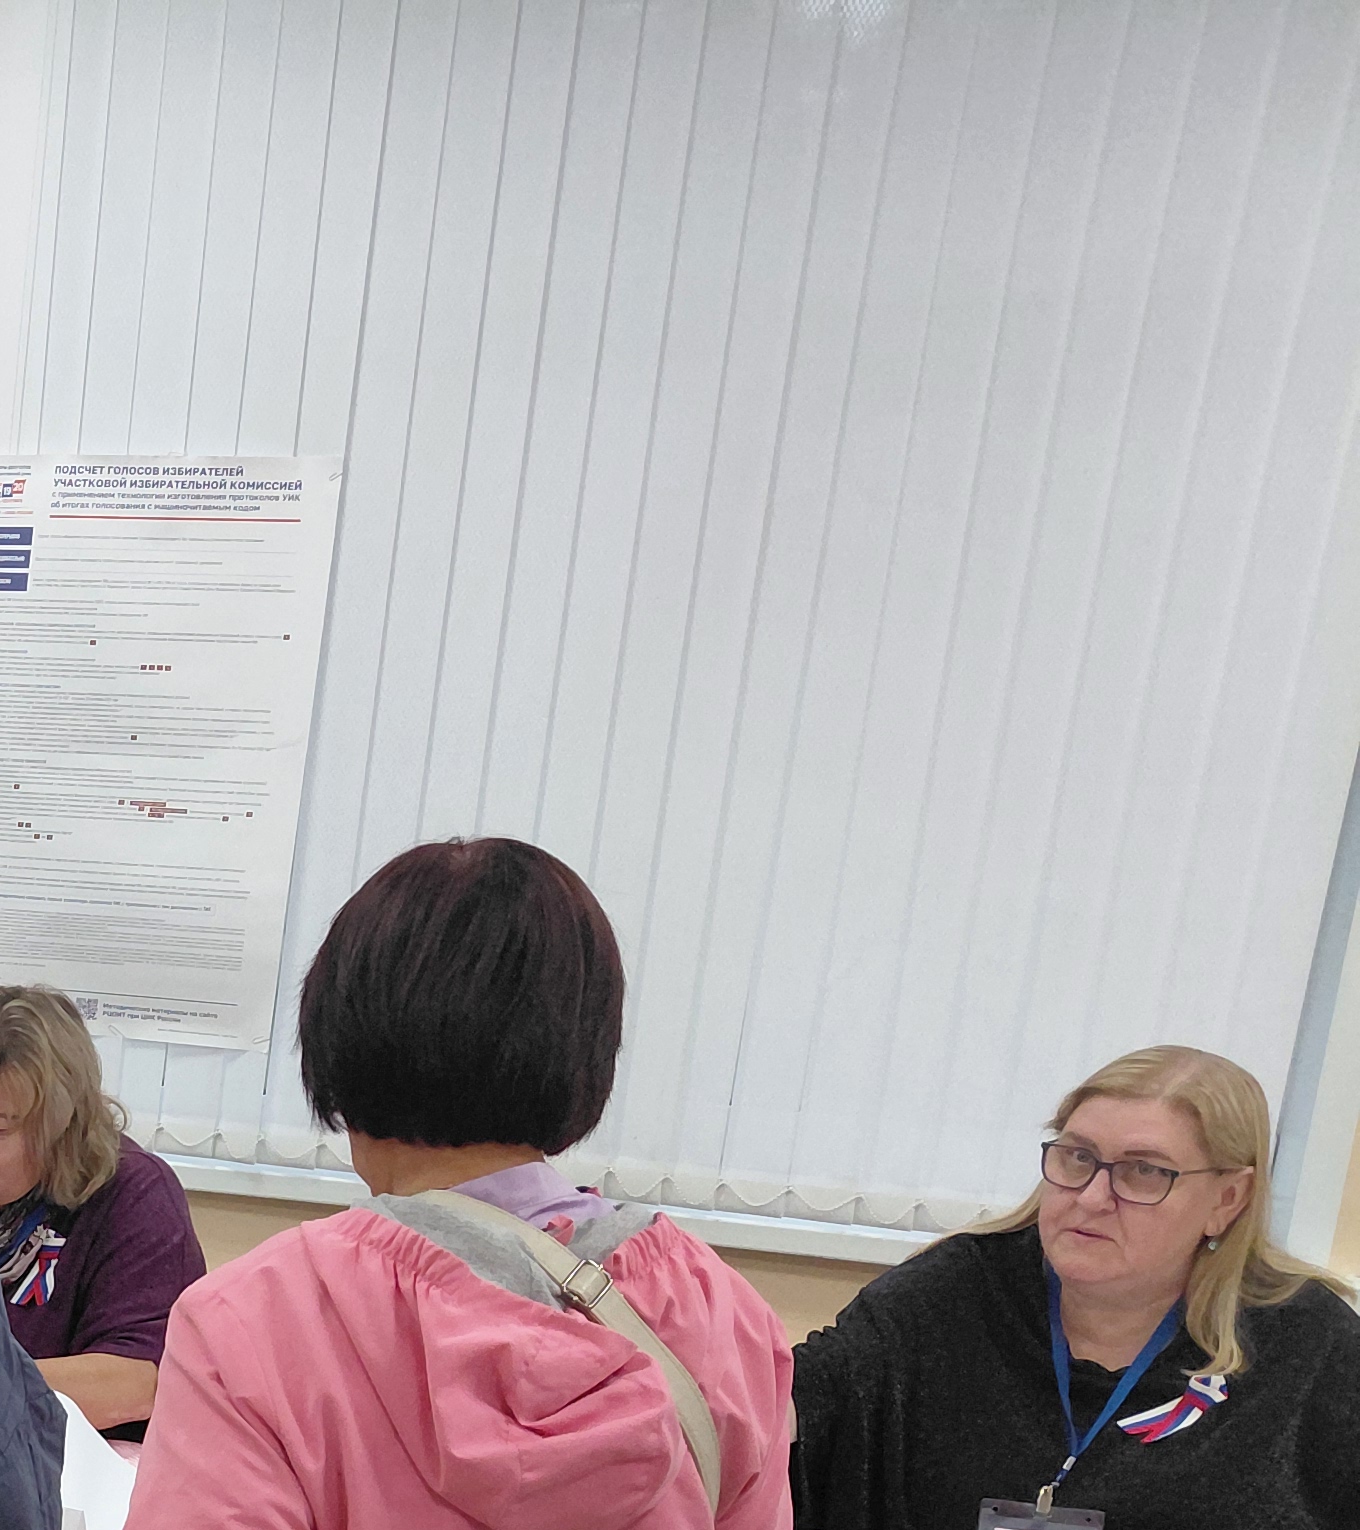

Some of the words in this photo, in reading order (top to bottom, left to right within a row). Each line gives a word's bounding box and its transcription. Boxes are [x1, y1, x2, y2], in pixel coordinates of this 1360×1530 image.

[55, 466, 105, 475] ПОДСЧЕТ
[107, 466, 159, 476] ГОЛОСОВ
[162, 466, 244, 477] ИЗБИРАТЕЛЕЙ
[53, 477, 126, 488] УЧАСТКОВОЙ
[129, 479, 227, 490] ИЗБИРАТЕЛЬНОЙ
[229, 480, 303, 491] КОМИССИЕЙ
[282, 494, 301, 502] УИК
